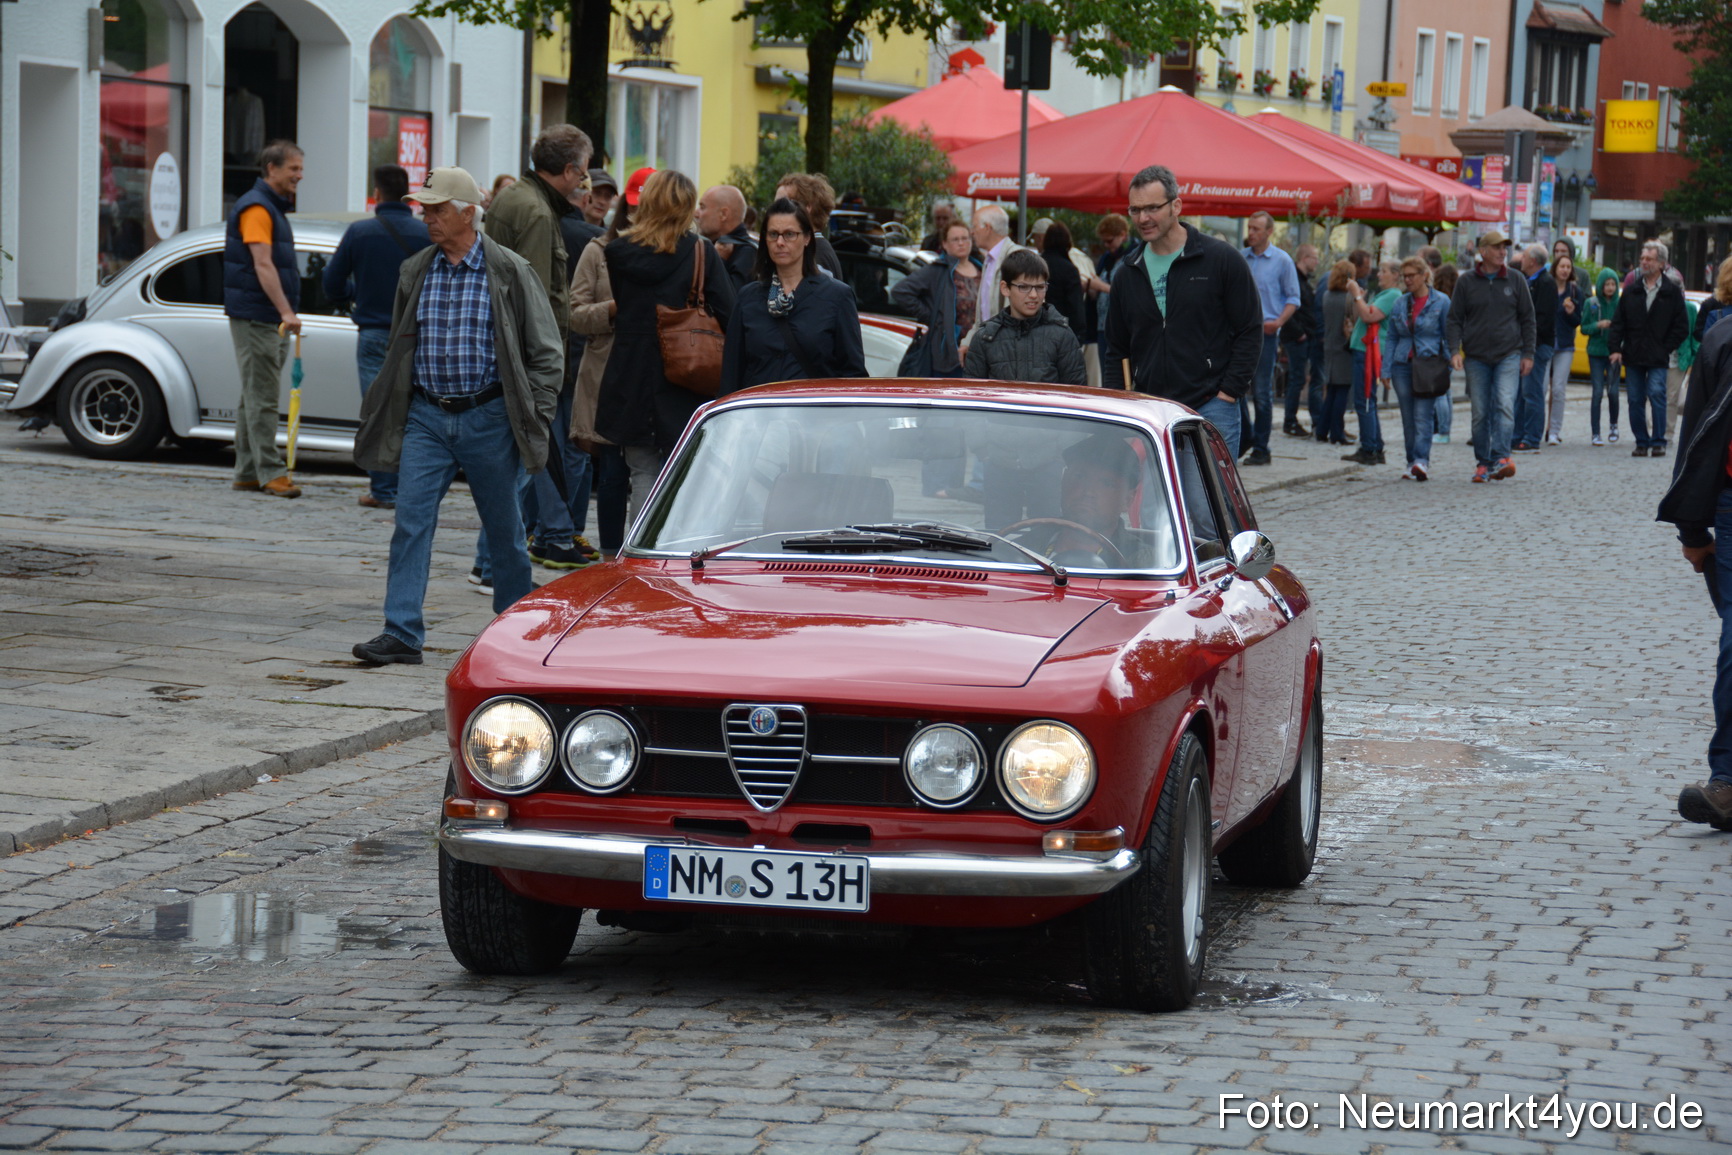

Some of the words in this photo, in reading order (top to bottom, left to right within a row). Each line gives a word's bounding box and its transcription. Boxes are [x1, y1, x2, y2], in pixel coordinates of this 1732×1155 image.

[400, 131, 427, 164] 30%
[1191, 183, 1255, 197] Restaurant
[1256, 185, 1312, 199] Lehmeier
[652, 877, 662, 890] D
[670, 854, 724, 896] NM
[749, 859, 774, 899] S
[786, 861, 864, 904] 13H
